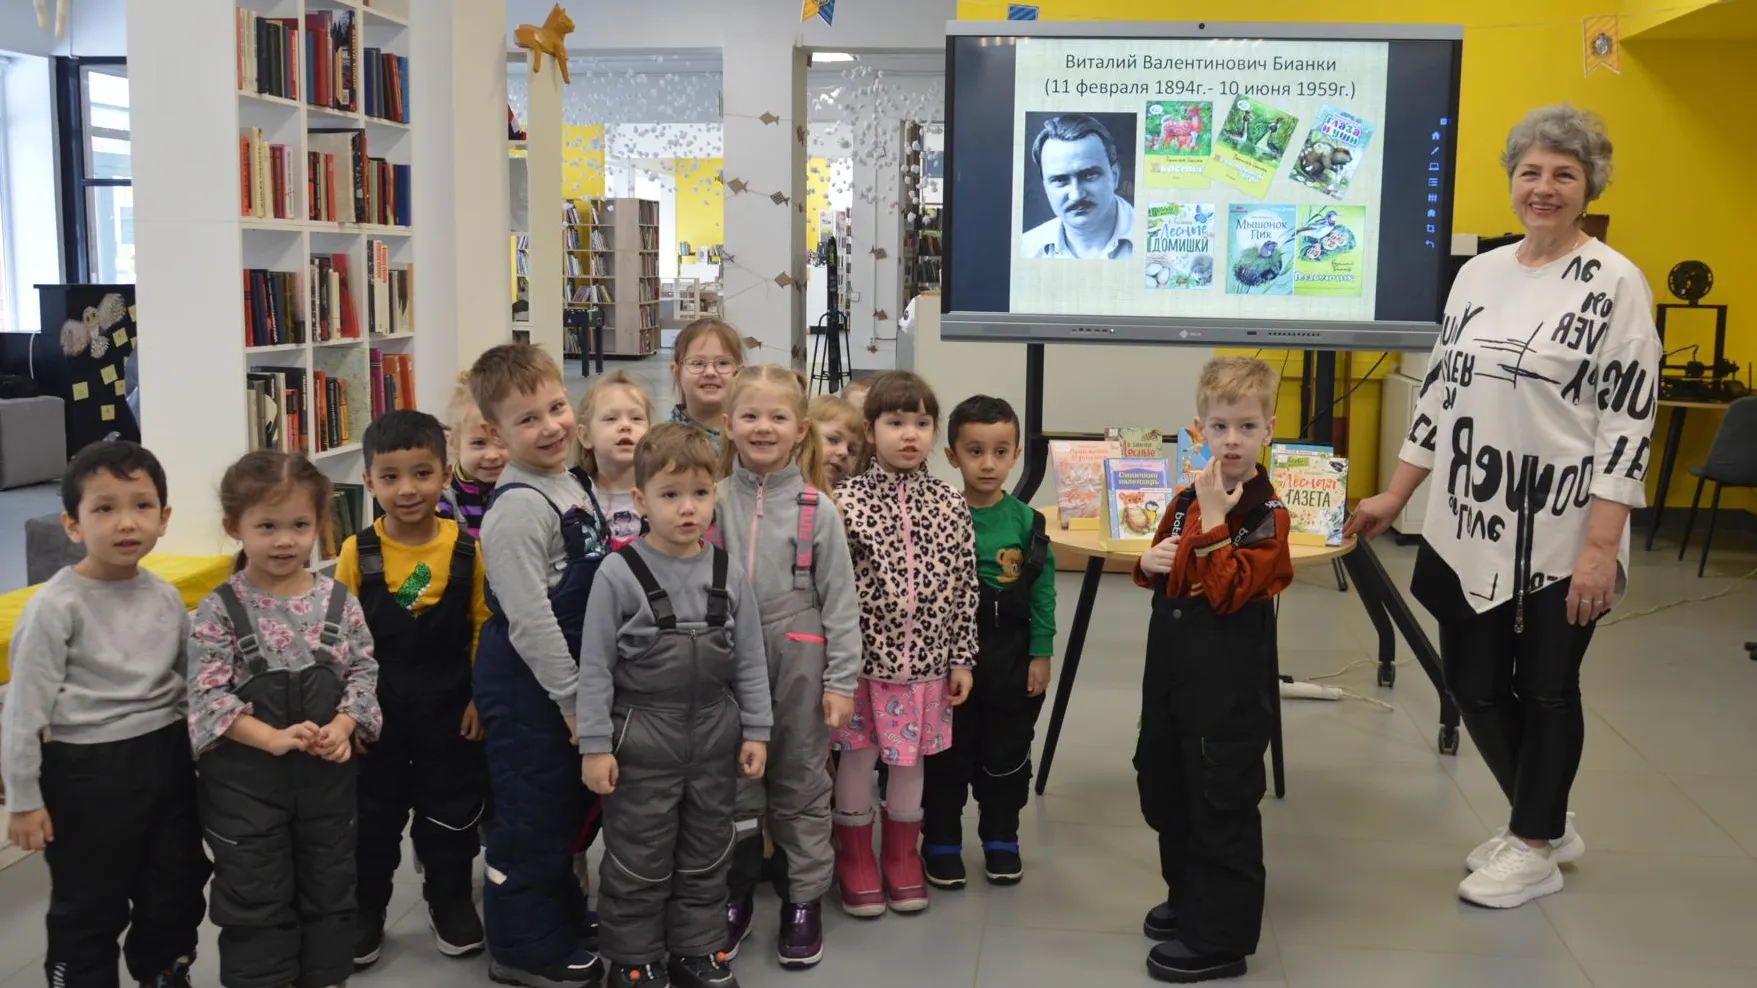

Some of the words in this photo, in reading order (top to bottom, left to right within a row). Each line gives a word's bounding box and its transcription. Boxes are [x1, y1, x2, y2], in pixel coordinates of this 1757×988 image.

[1065, 54, 1137, 69] Виталий
[1143, 55, 1267, 71] Валентинович
[1273, 56, 1337, 71] Бианки
[1045, 78, 1070, 96] (11
[1076, 79, 1149, 98] февраля
[1219, 80, 1239, 96] 10
[1244, 83, 1291, 97] июня
[1297, 81, 1356, 100] 1959г.)
[1160, 223, 1208, 240] Лесные
[1236, 219, 1287, 230] Мышонок
[1251, 230, 1272, 240] Пик
[1152, 238, 1209, 253] ДОМИШКИ
[1282, 473, 1336, 490] Лесная
[1287, 489, 1331, 507] ГАЗЕТА
